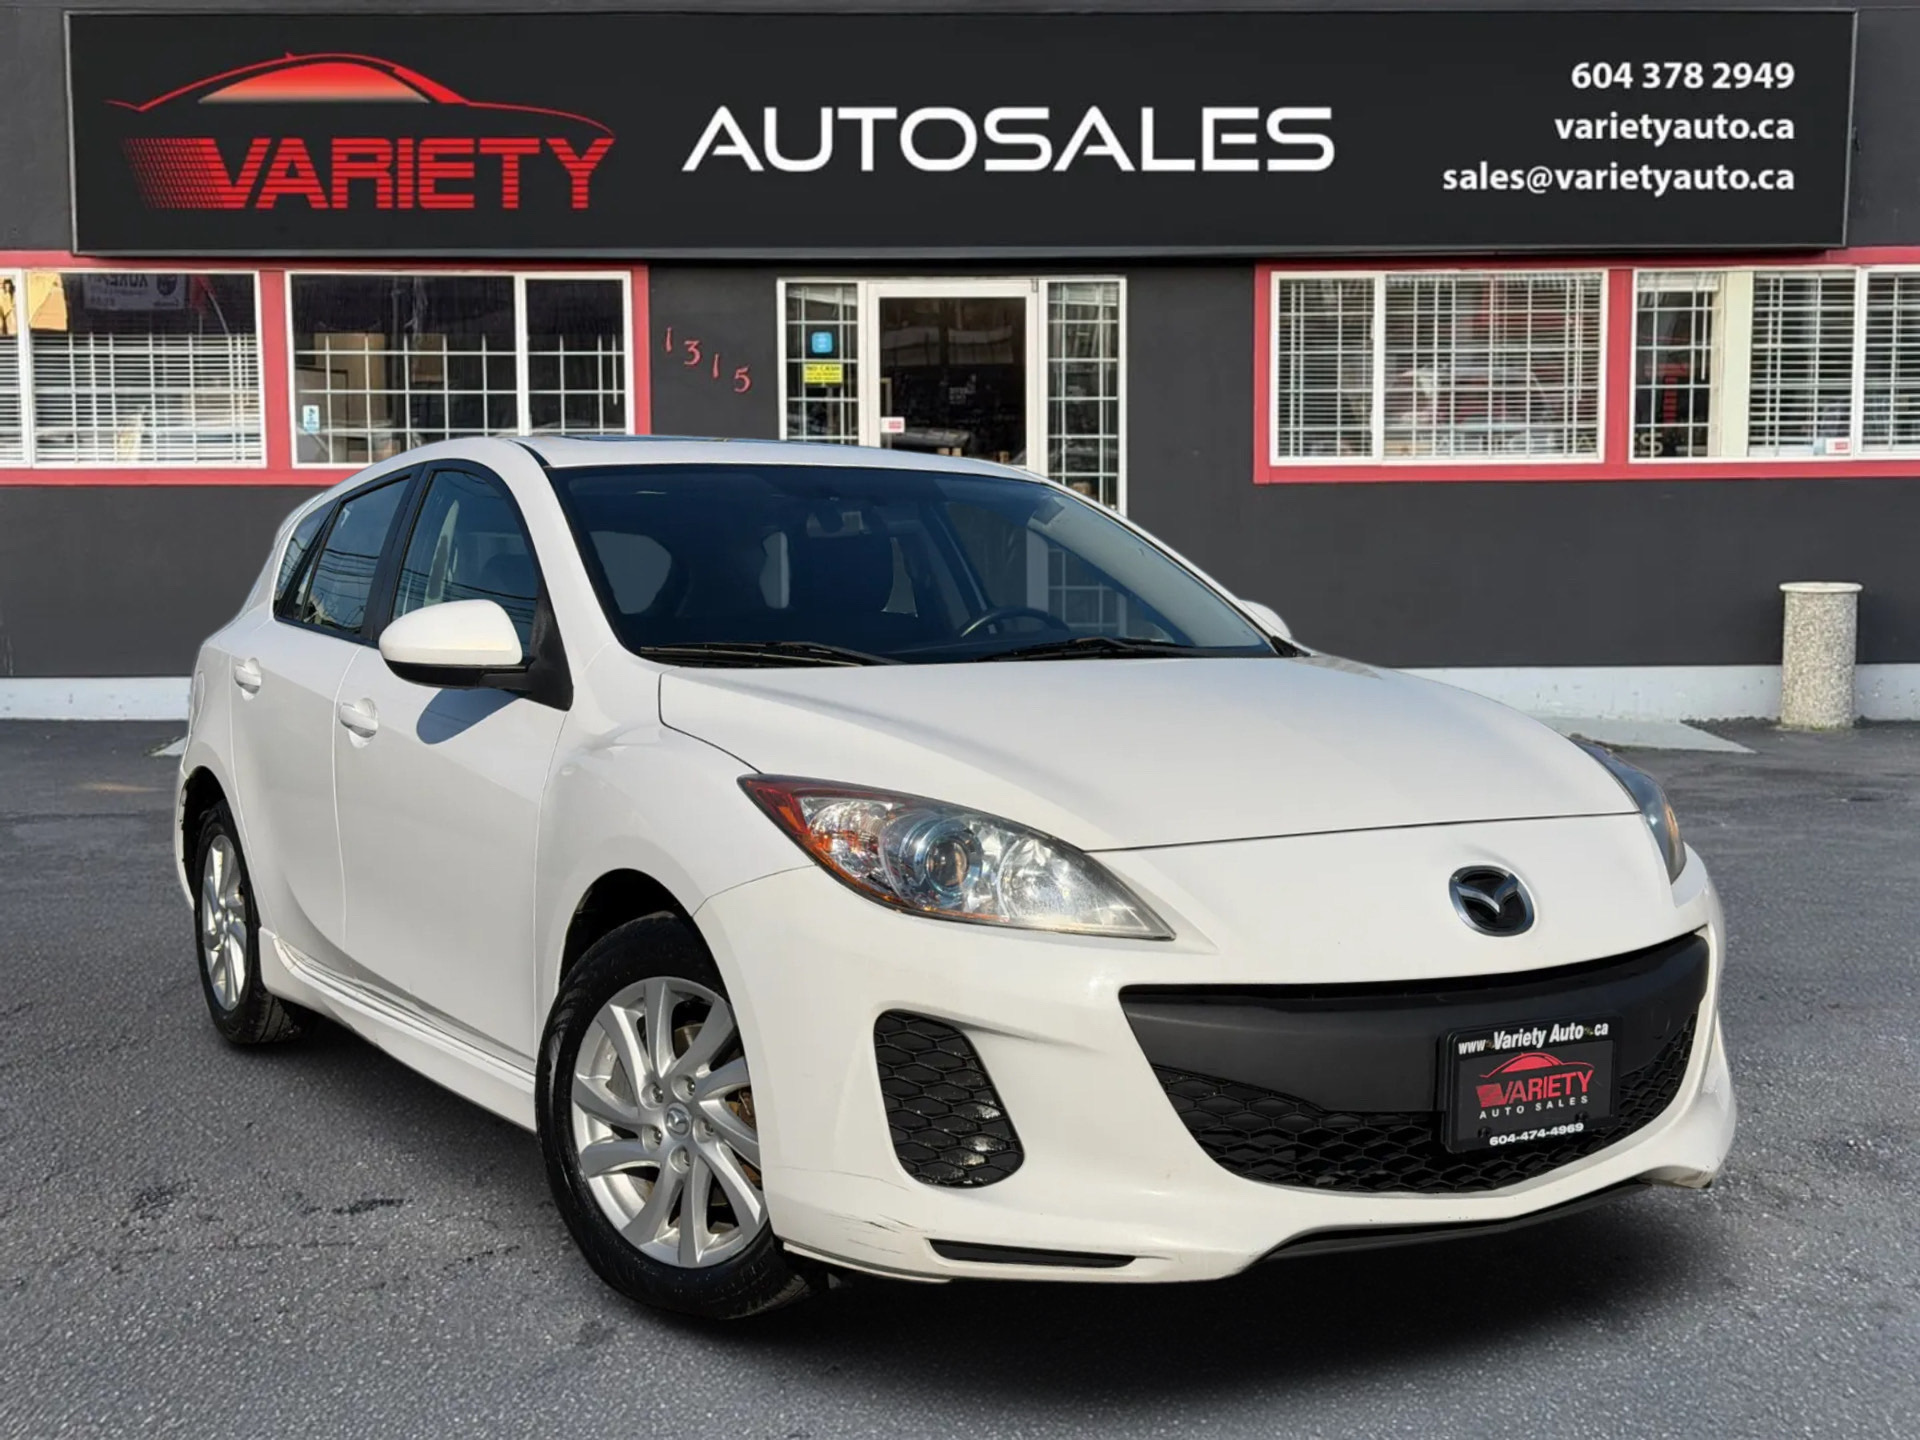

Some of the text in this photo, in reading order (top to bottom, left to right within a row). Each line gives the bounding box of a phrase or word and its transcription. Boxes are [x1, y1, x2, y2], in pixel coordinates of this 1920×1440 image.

[1571, 61, 1795, 89] 604 378 2949
[682, 106, 1335, 172] AUTOSALES
[1554, 111, 1795, 148] varietyauto.ca
[190, 137, 615, 210] VARIETY
[1443, 160, 1795, 197] sales@varietyauto.ca
[665, 326, 752, 394] 1315
[1493, 1027, 1547, 1050] Variety
[1480, 1069, 1594, 1107] VARIETY
[1479, 1095, 1589, 1120] AUTO SALES
[1489, 1122, 1584, 1146] 604-474-4969
